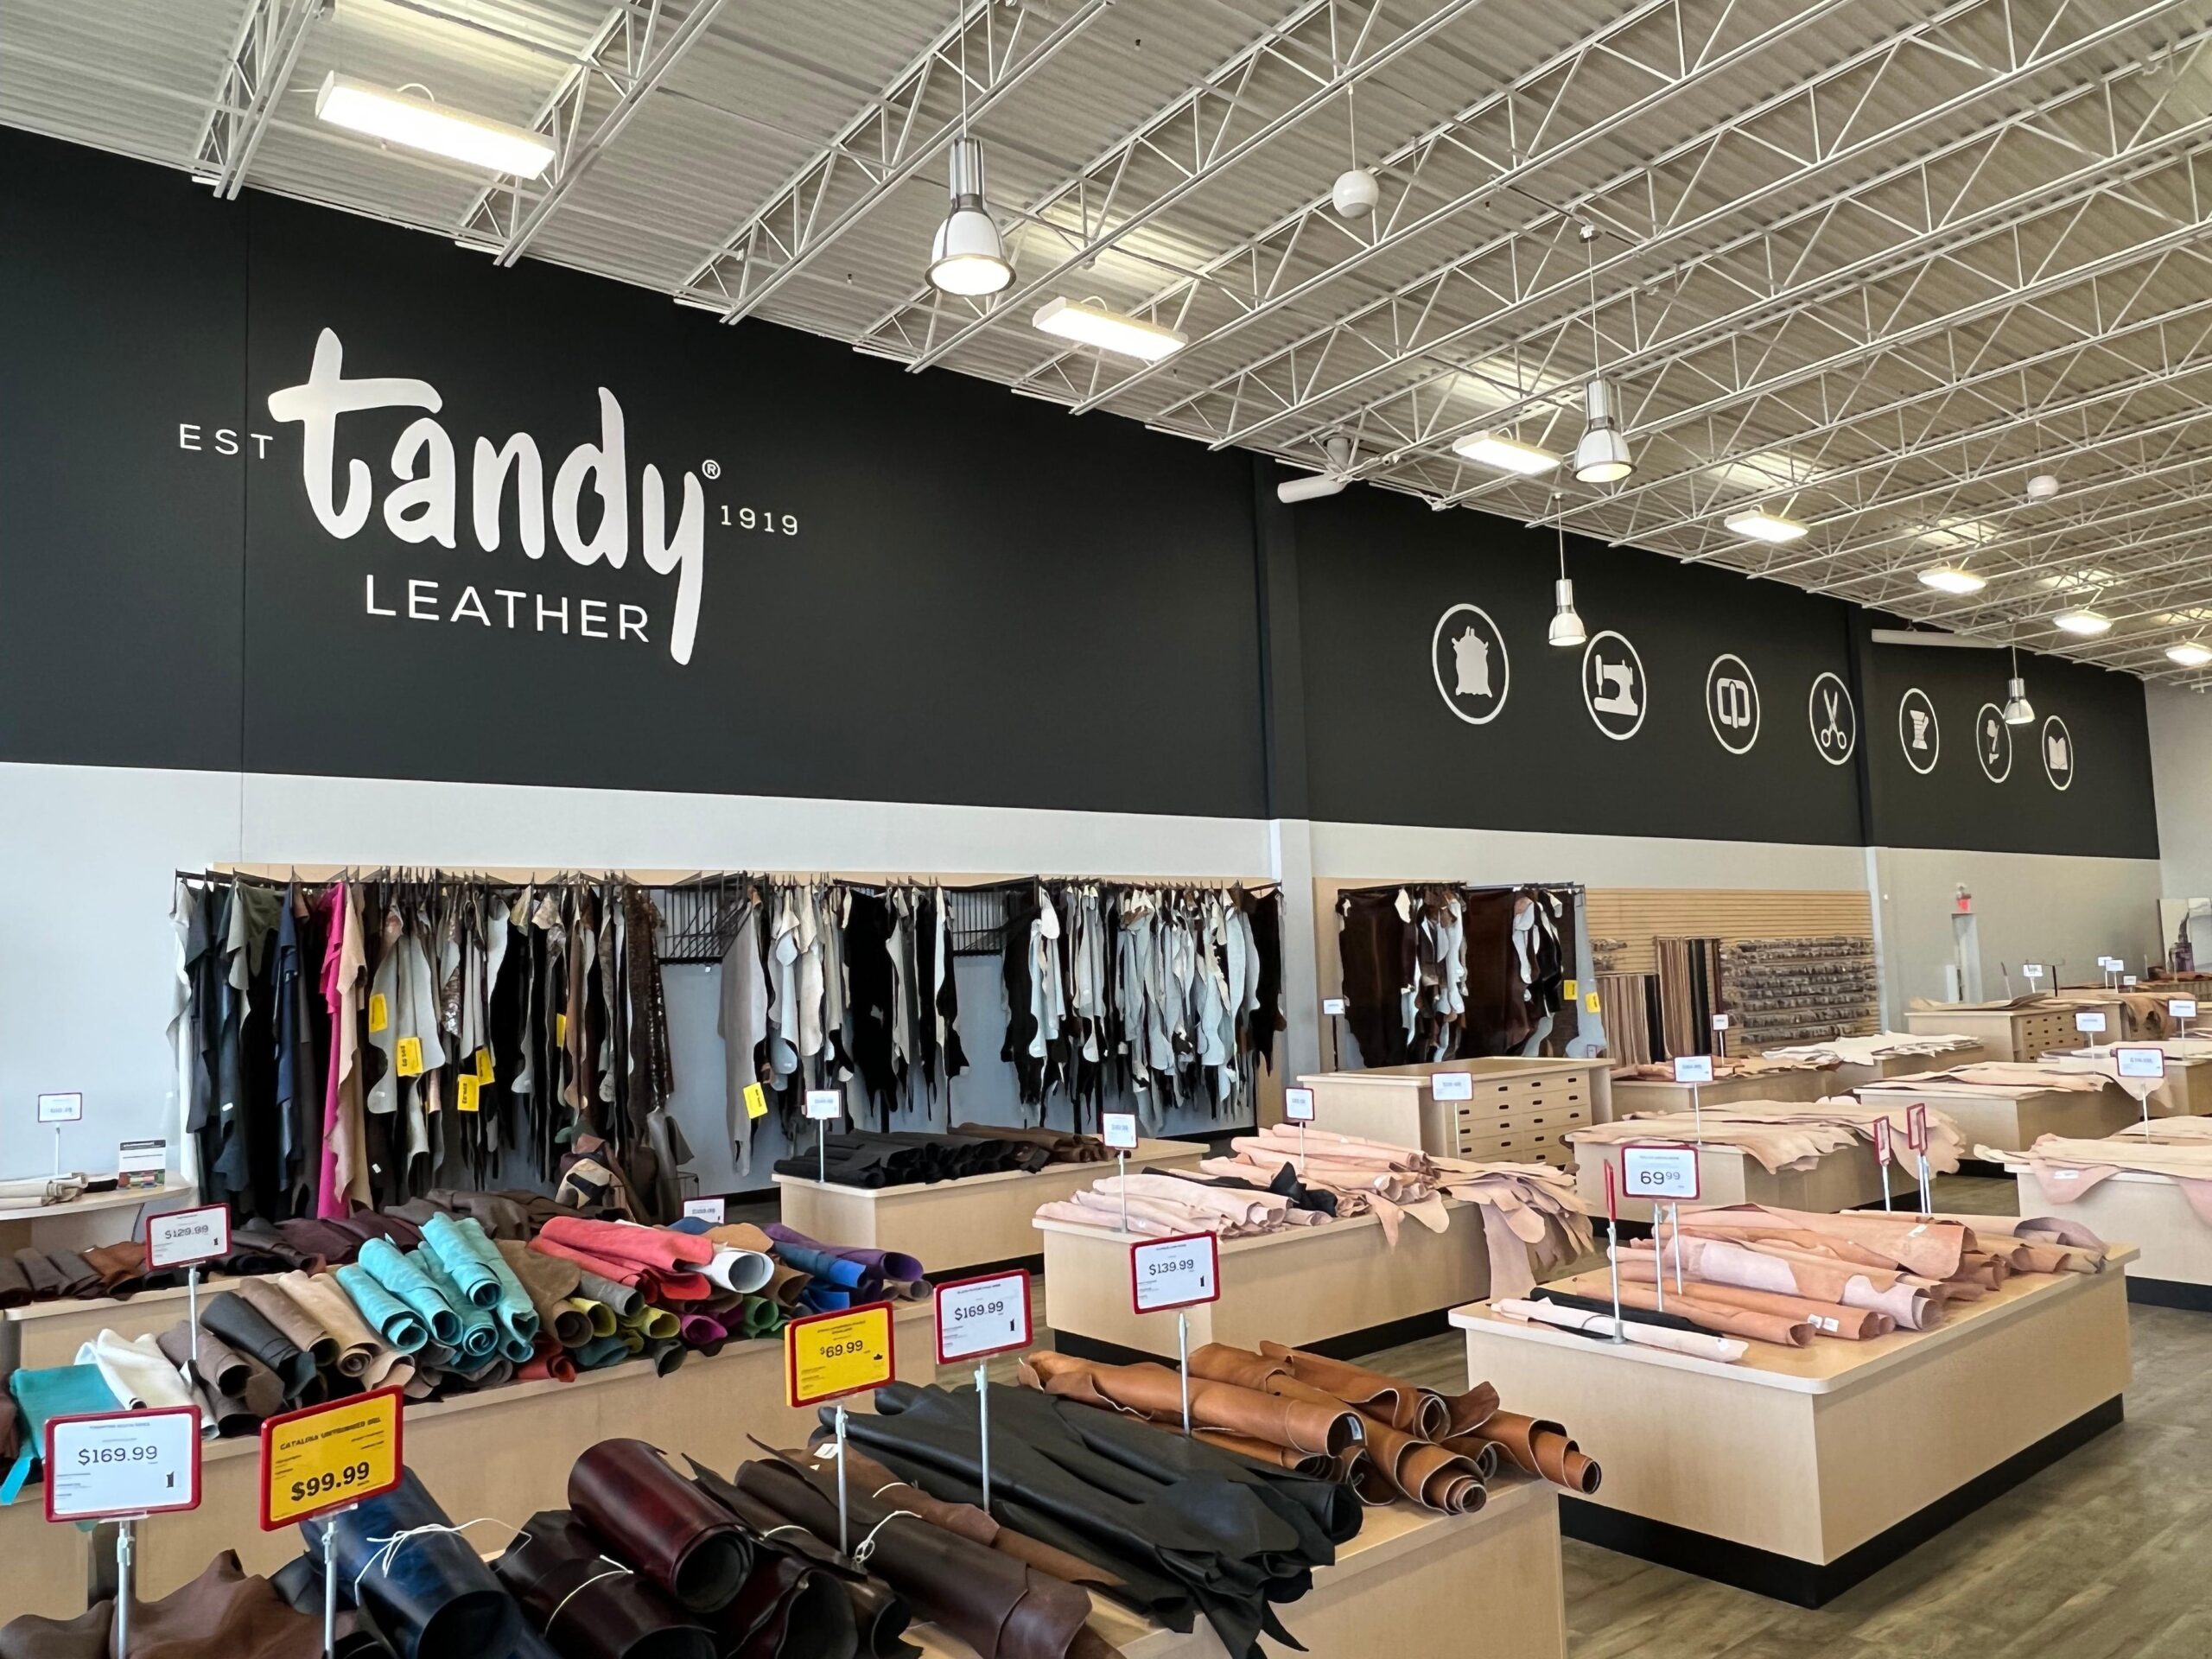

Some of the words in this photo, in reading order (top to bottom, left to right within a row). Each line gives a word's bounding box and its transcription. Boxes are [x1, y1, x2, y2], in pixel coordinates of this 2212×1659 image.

[179, 423, 274, 460] EST
[268, 327, 704, 665] tandy
[721, 505, 798, 536] 1919
[365, 574, 650, 643] LEATHER
[1148, 1259, 1194, 1275] $139.99
[954, 1300, 1004, 1320] $169.99
[819, 1339, 864, 1359] $69.99
[78, 1446, 157, 1466] $169.99
[290, 1461, 370, 1502] $99.99
